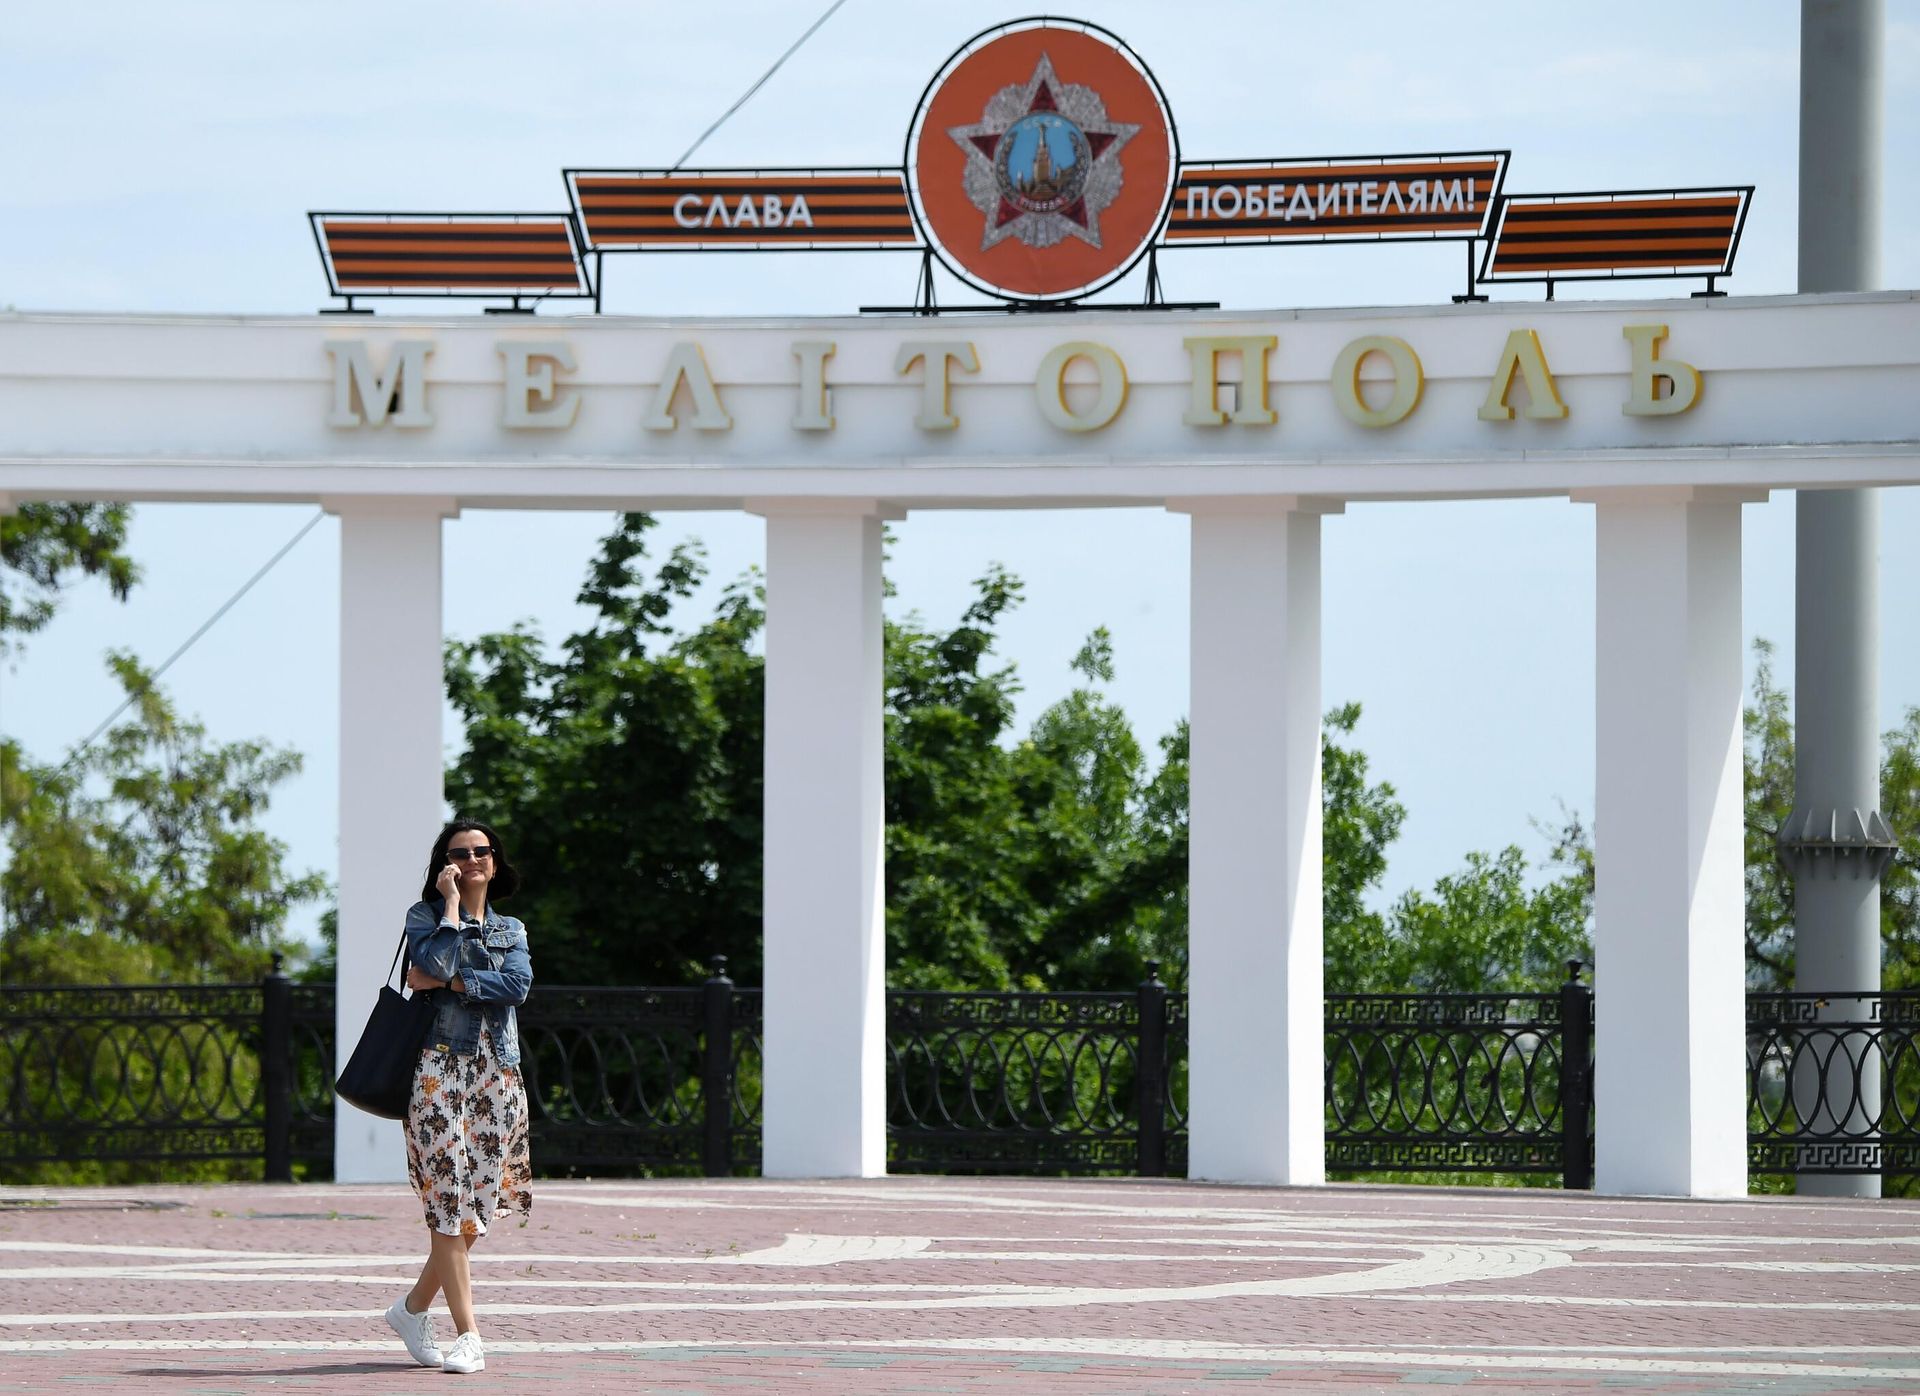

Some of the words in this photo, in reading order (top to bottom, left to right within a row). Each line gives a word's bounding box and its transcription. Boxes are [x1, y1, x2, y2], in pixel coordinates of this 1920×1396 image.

[673, 193, 814, 228] СЛАВА
[1187, 177, 1475, 221] ПОБЕДИТЕЛЯМ!
[324, 325, 1703, 433] МЕЛІТОПОЛЬ
